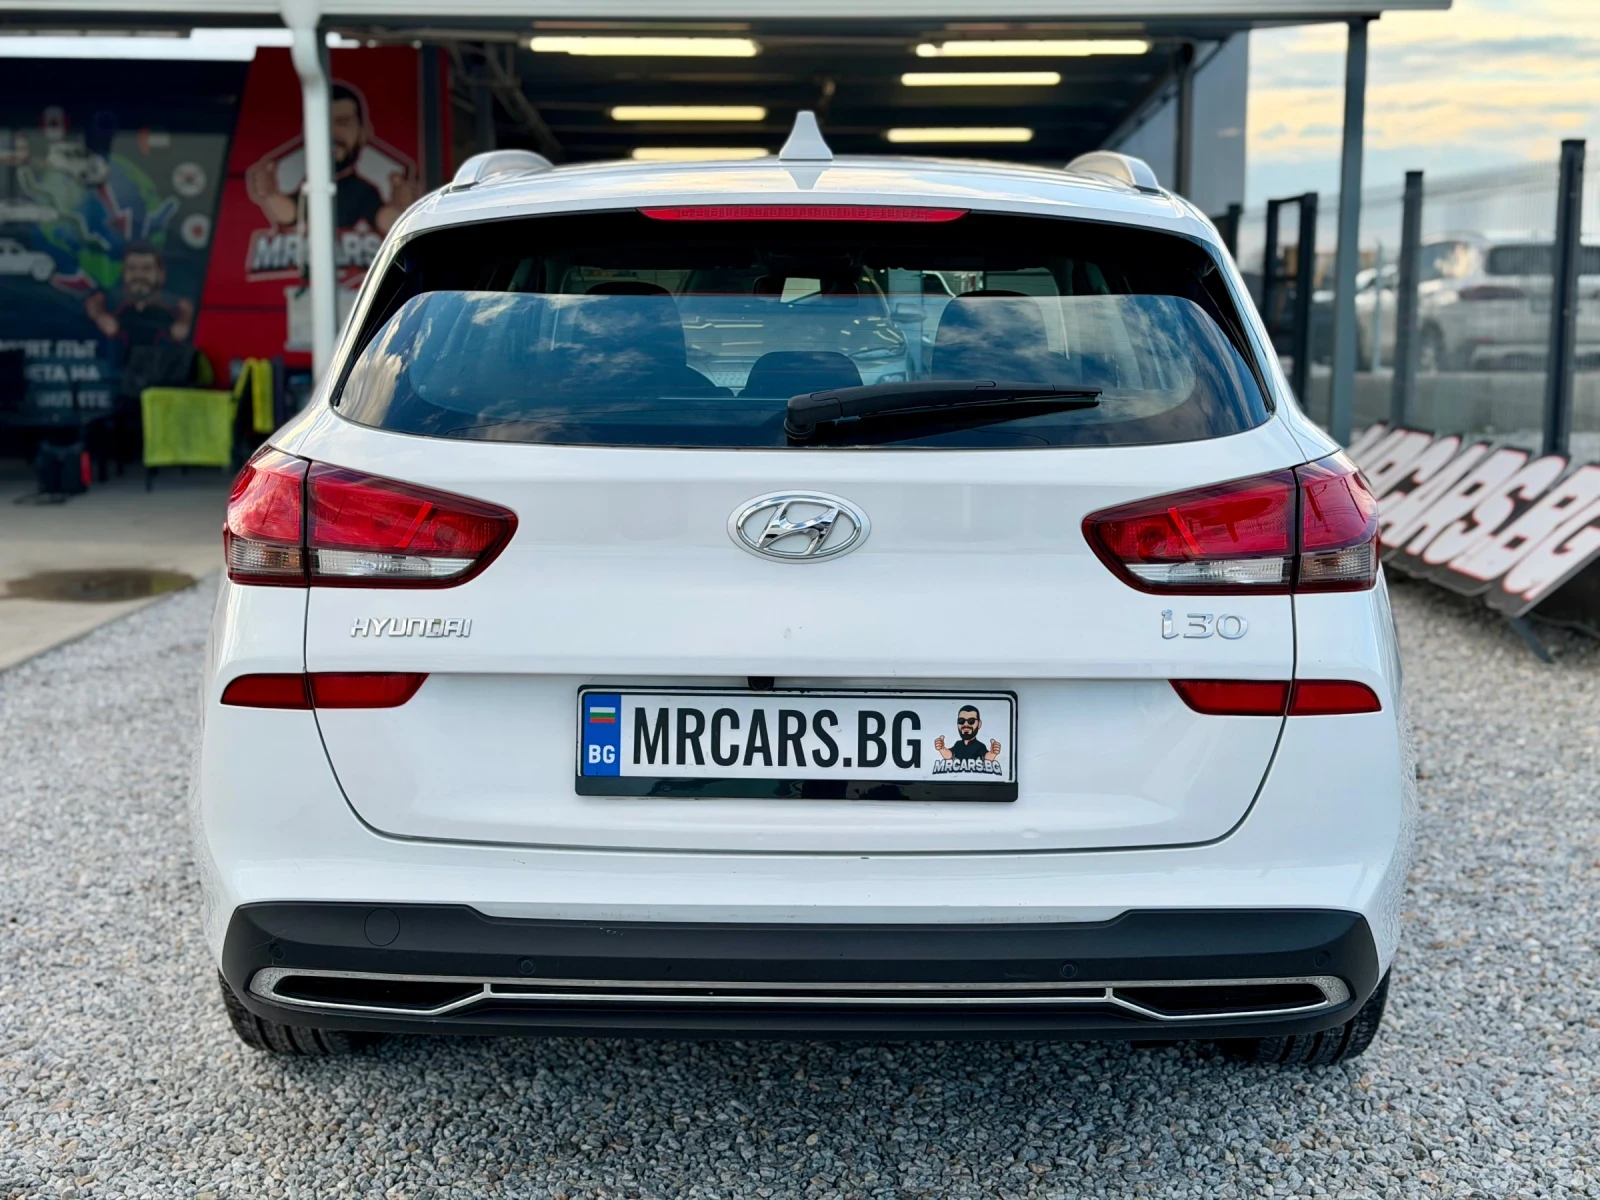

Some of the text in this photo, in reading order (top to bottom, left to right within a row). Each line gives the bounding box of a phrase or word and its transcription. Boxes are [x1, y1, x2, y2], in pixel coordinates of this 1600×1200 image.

[350, 617, 472, 638] HYUNDAI
[1161, 609, 1248, 640] i30
[632, 706, 922, 769] MRCARS.BG
[588, 744, 616, 764] BG
[932, 758, 1003, 776] MRCARS.BG
